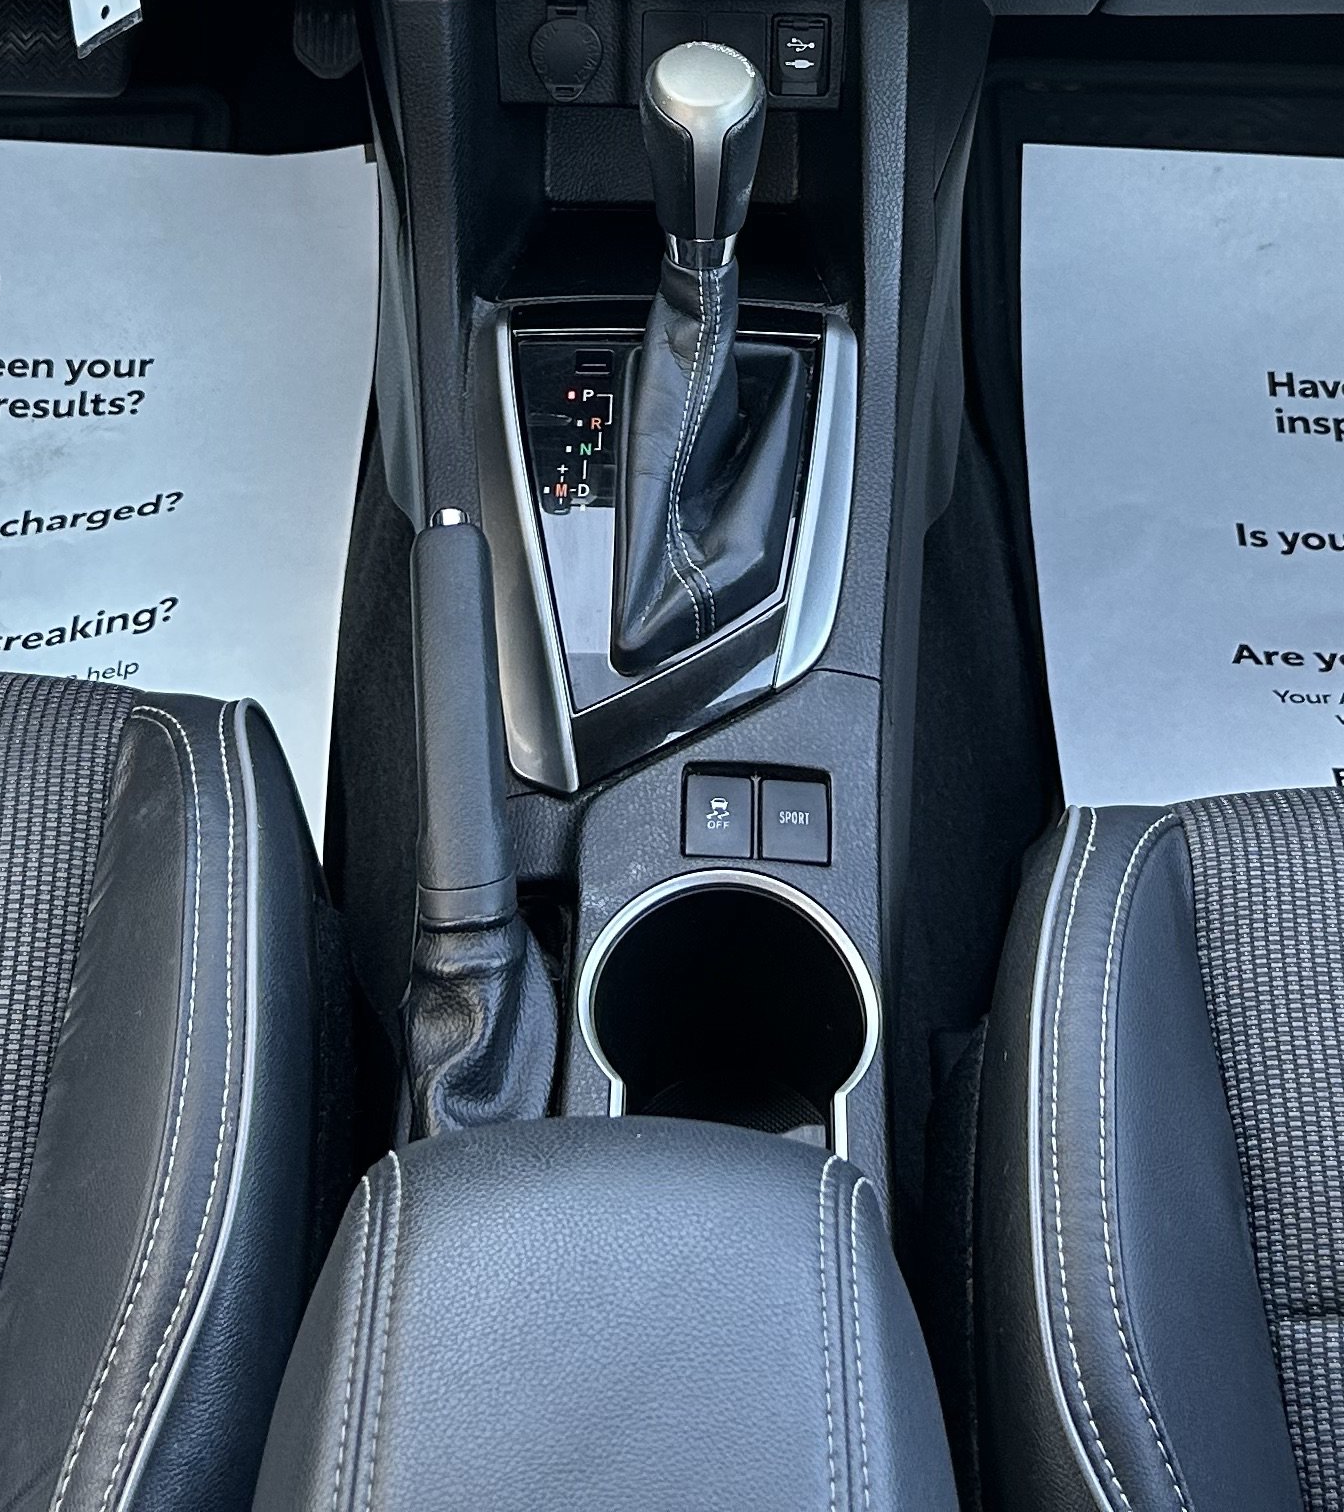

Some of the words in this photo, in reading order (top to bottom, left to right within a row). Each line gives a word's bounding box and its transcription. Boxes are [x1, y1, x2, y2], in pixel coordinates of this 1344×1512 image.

[64, 355, 154, 387] your
[582, 389, 595, 402] P
[590, 417, 602, 430] R
[579, 442, 592, 456] N
[555, 483, 568, 498] M
[577, 483, 590, 497] D
[0, 491, 185, 539] charged?
[1235, 522, 1269, 549] Is
[1232, 644, 1305, 666] Are
[87, 660, 139, 681] help
[1273, 689, 1330, 706] Your
[707, 820, 730, 830] OFF
[778, 811, 810, 825] SPORT
